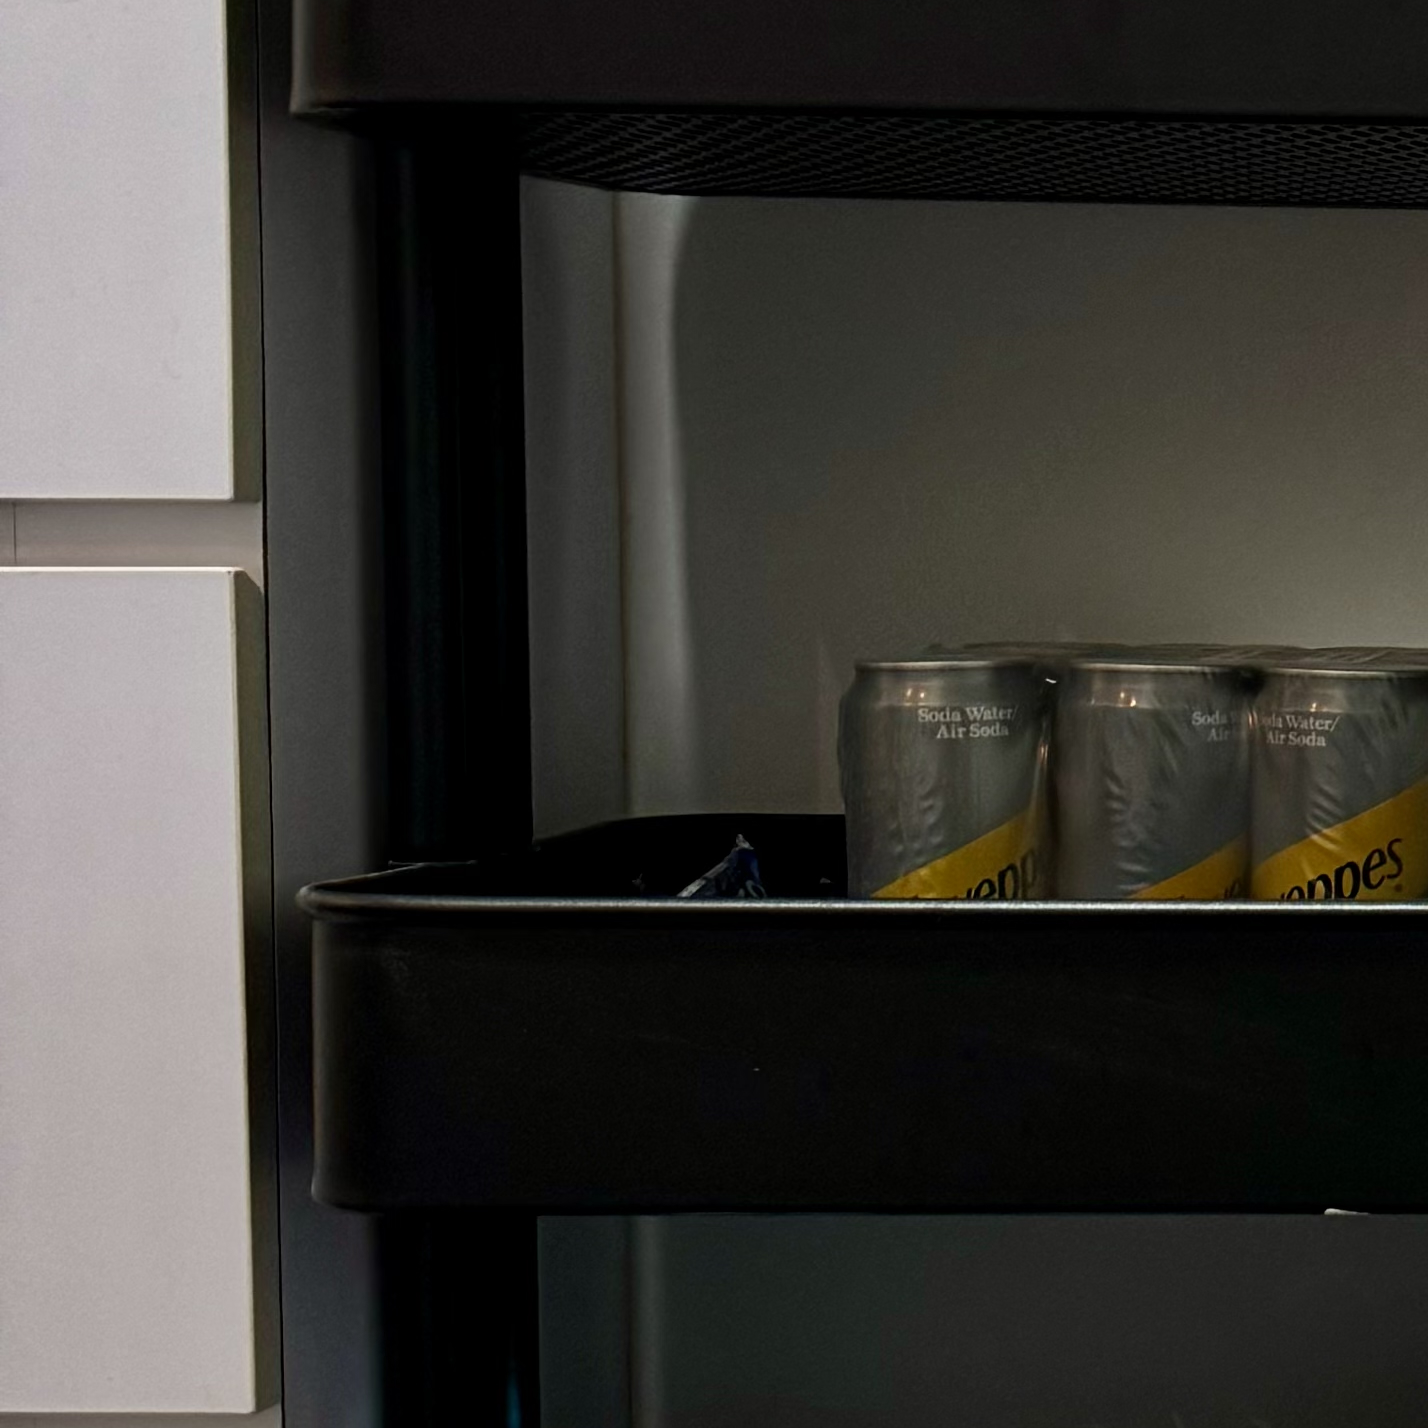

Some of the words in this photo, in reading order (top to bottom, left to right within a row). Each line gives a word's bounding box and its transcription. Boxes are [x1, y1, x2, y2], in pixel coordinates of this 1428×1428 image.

[917, 707, 961, 723] Soda
[1285, 714, 1341, 732] Water/
[936, 724, 967, 739] Air
[969, 722, 1010, 738] Soda
[1266, 732, 1286, 745] Air
[1288, 732, 1326, 747] Soda
